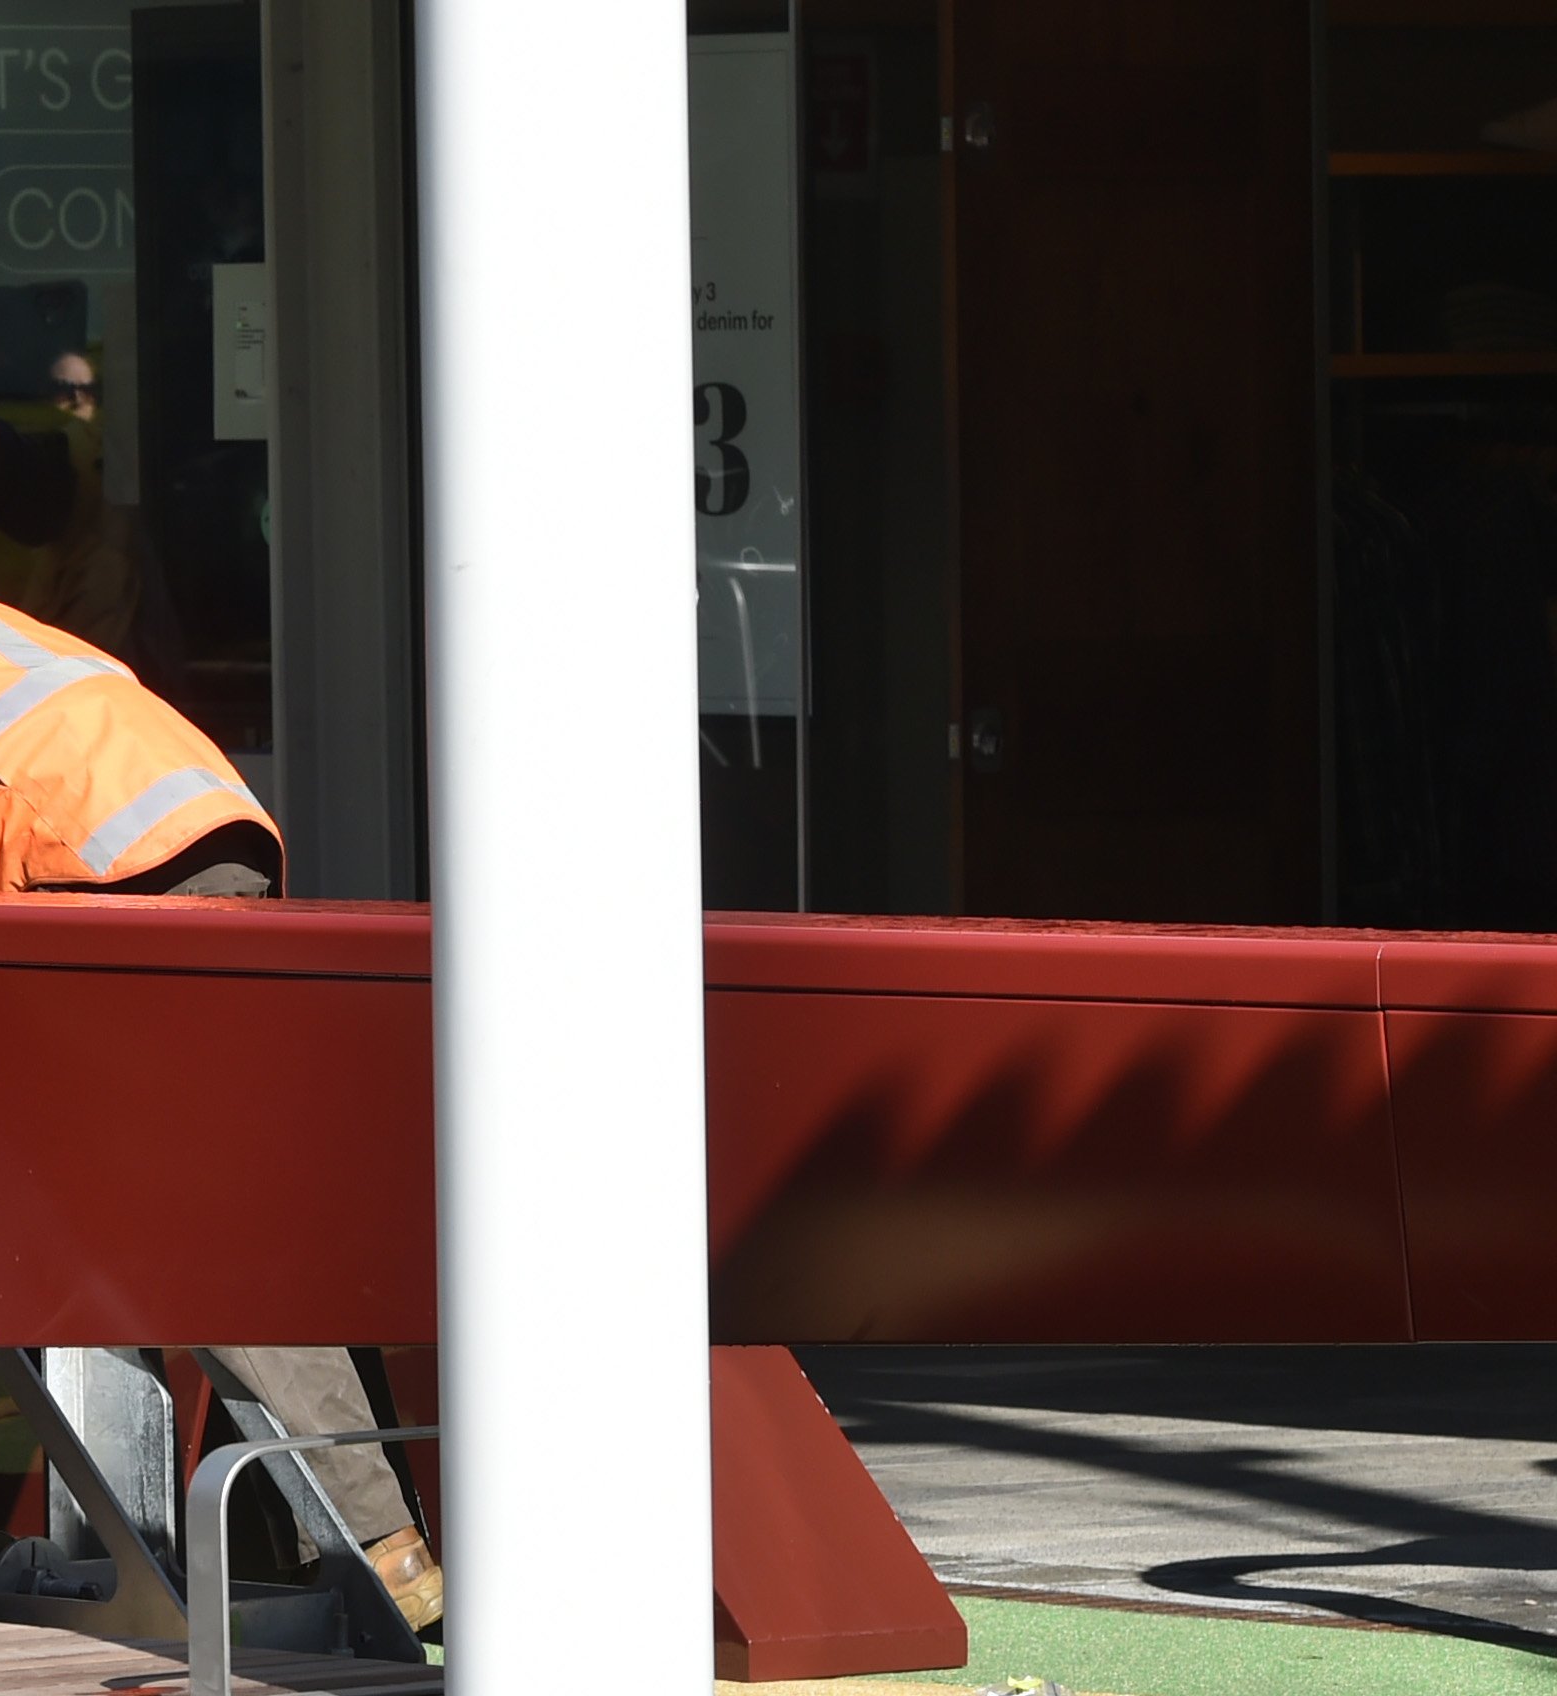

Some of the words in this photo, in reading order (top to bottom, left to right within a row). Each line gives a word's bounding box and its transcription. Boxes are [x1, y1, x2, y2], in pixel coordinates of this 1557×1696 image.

[706, 282, 717, 300] 3
[697, 312, 748, 330] denim
[752, 311, 774, 330] for
